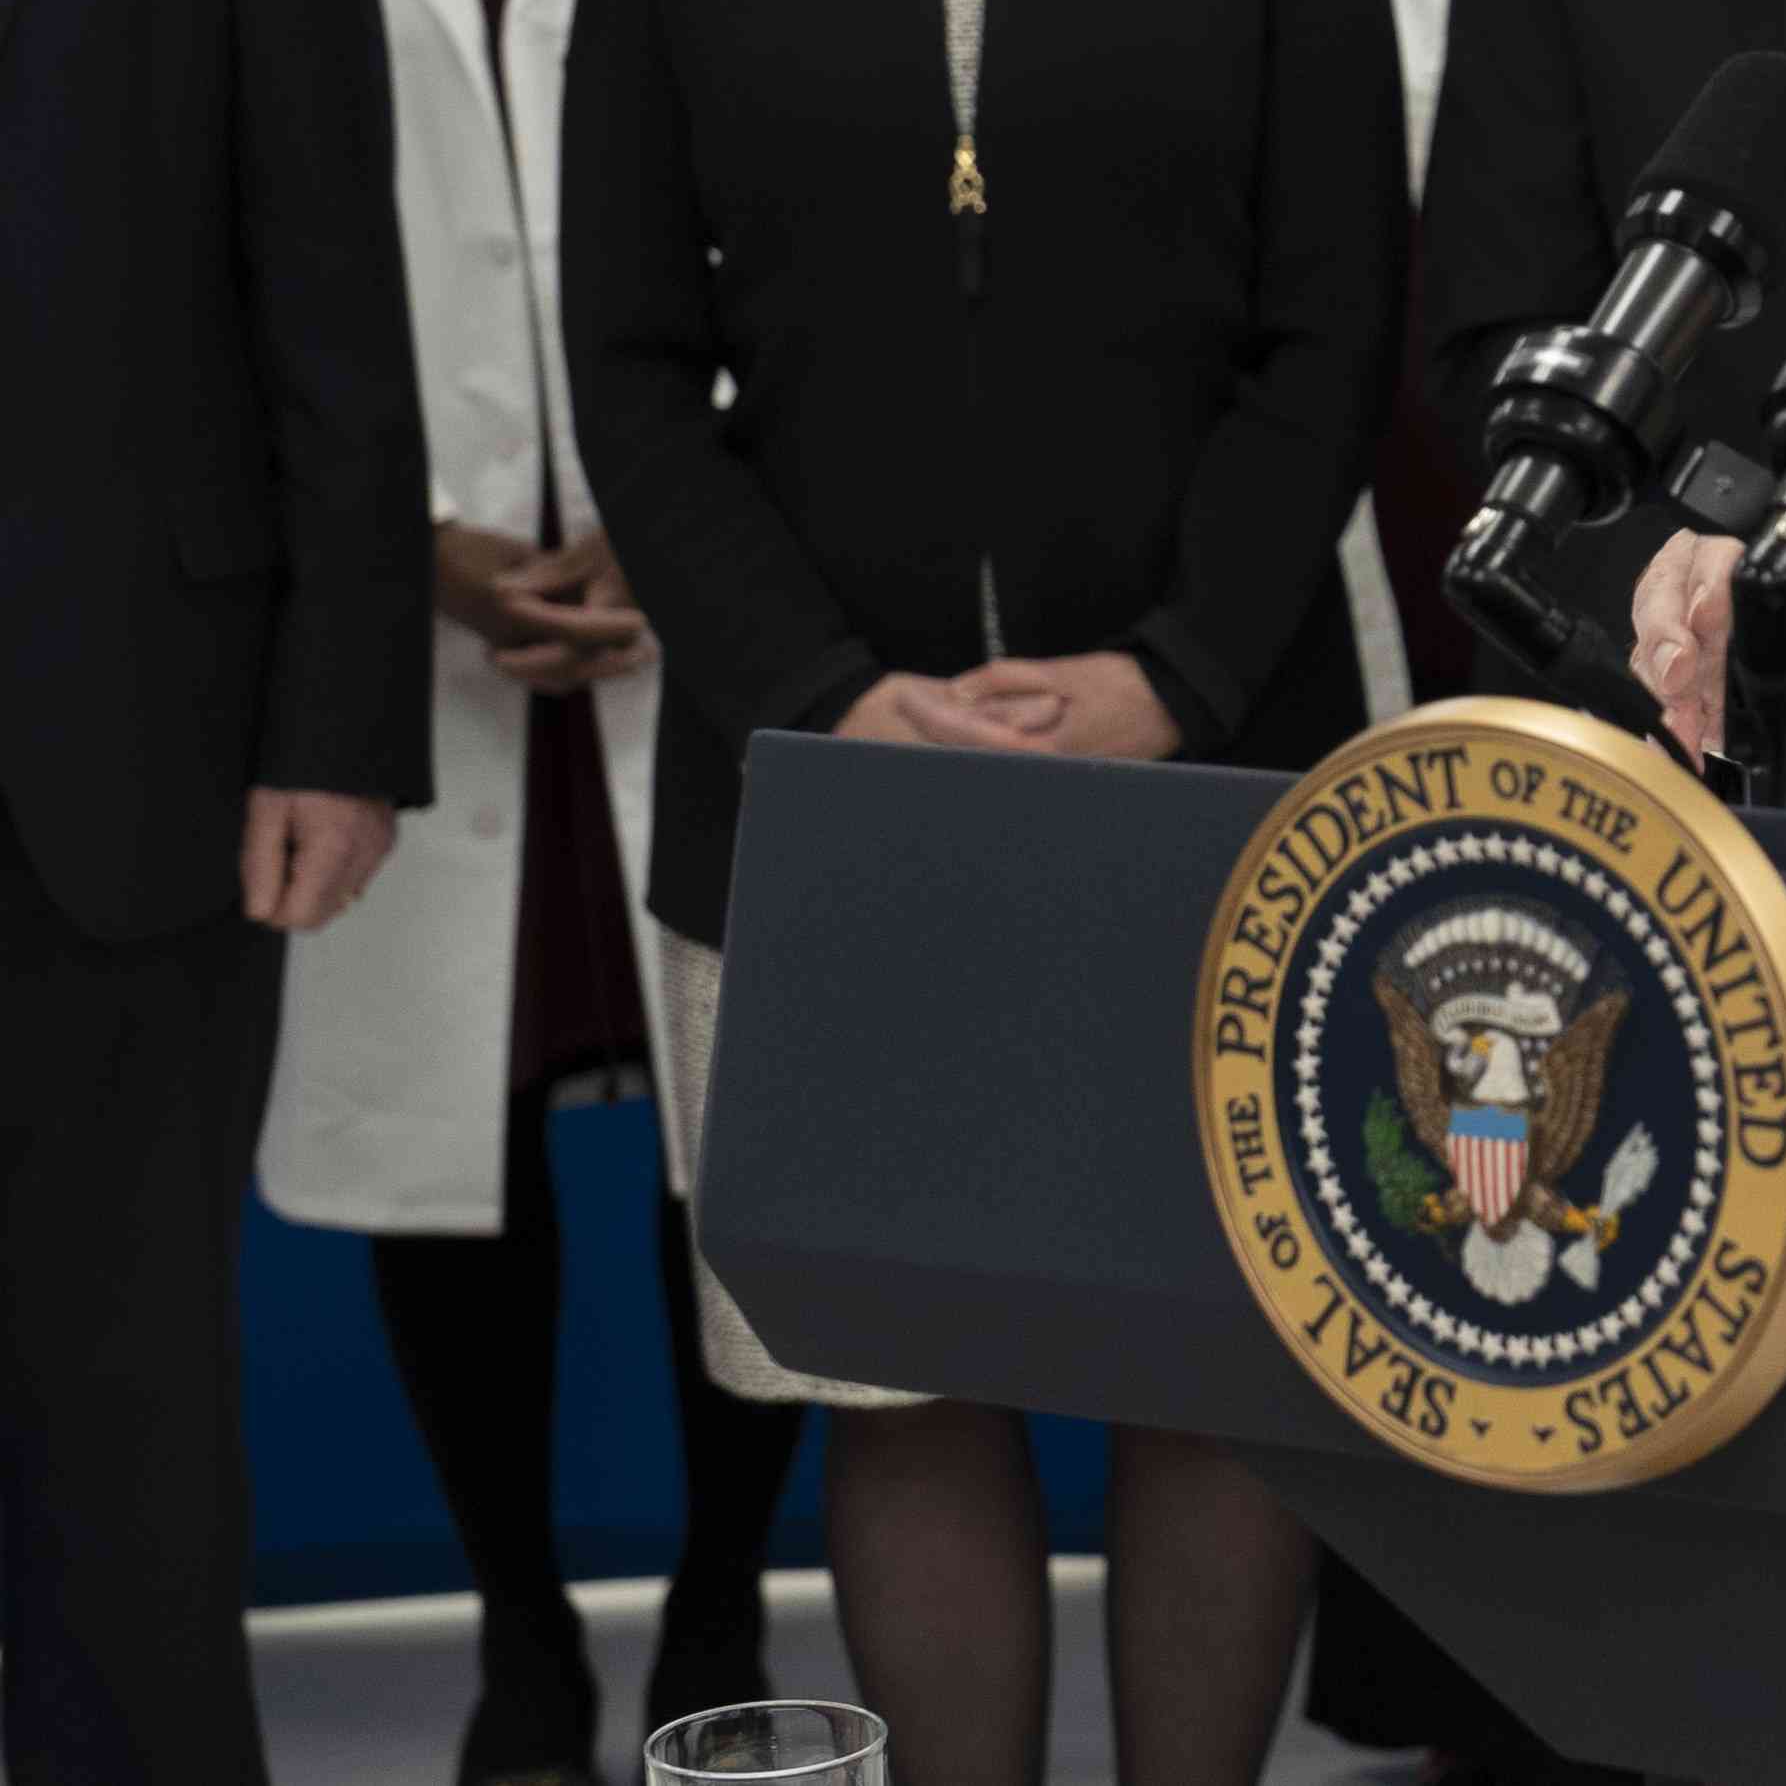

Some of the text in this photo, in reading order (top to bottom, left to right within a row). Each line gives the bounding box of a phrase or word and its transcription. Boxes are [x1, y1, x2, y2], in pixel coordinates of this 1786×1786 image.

[1490, 758, 1545, 806] OF
[1559, 779, 1639, 851] THE
[1216, 747, 1470, 1065] PRESIDENT
[1224, 1093, 1274, 1194] THE
[1251, 1210, 1299, 1270] OF
[1300, 1272, 1456, 1438] SEAL
[1566, 1237, 1769, 1455] STATES
